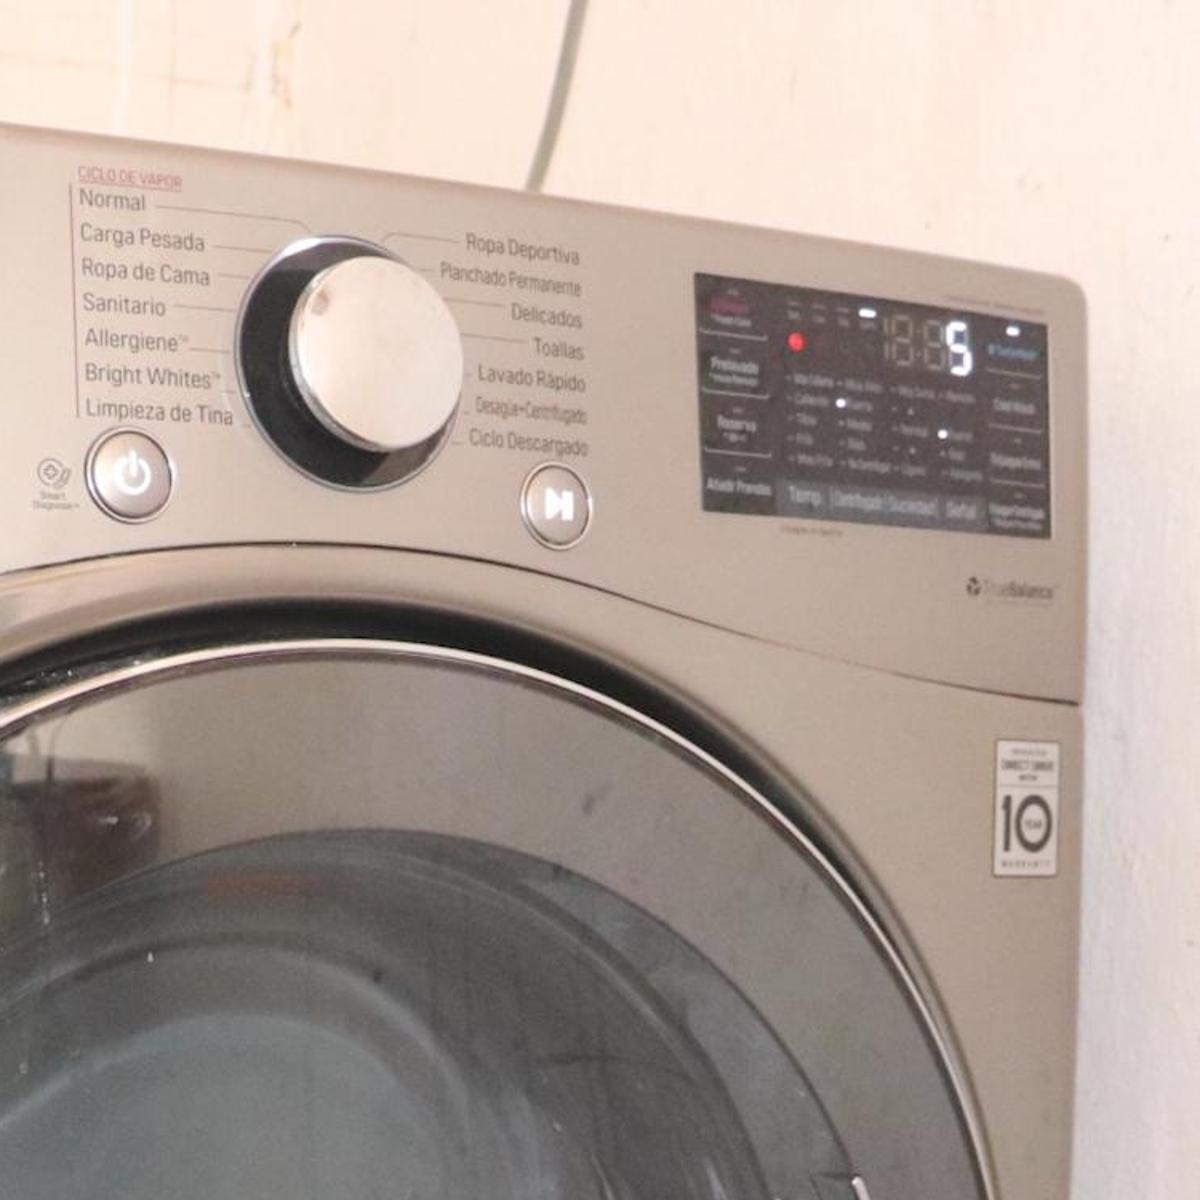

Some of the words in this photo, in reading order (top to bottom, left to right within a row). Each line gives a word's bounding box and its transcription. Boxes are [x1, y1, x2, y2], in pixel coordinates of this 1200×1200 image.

[79, 188, 146, 211] Normal
[80, 222, 135, 248] Carga
[140, 228, 205, 252] Pesada
[466, 232, 505, 256] Ropa
[508, 238, 580, 265] Deportiva
[82, 257, 128, 281] Ropa
[133, 262, 155, 282] de
[160, 264, 210, 286] Cama
[440, 261, 506, 287] Planchado
[509, 271, 581, 297] Permanente
[82, 292, 166, 317] Sanitario
[511, 302, 583, 329] Delicados
[534, 337, 585, 361] Toallas
[85, 362, 142, 387] Bright
[478, 362, 532, 387] Lavado
[85, 398, 165, 422] Limpieza
[170, 404, 192, 422] de
[197, 405, 233, 426] Tina
[469, 427, 504, 449] Ciclo
[507, 431, 589, 458] Descargado
[1002, 795, 1053, 853] 10
